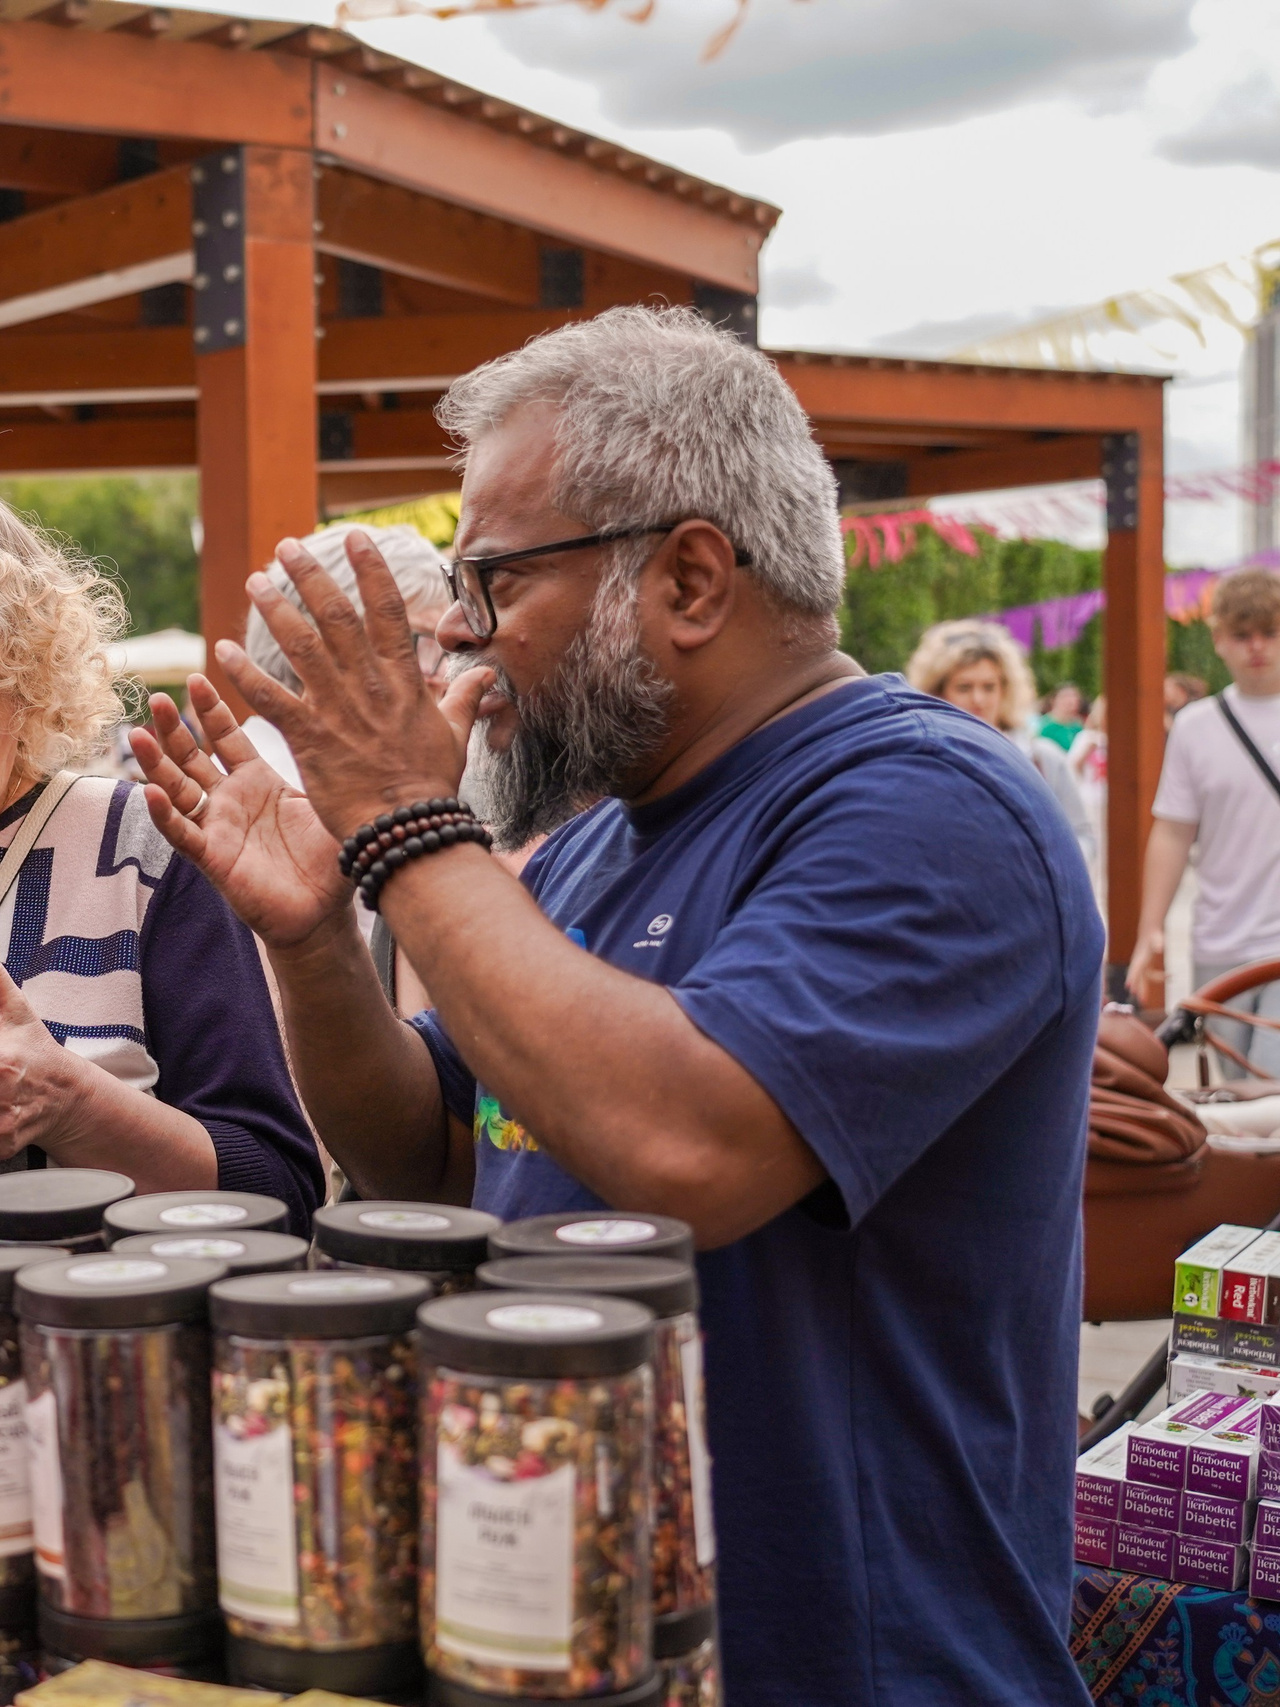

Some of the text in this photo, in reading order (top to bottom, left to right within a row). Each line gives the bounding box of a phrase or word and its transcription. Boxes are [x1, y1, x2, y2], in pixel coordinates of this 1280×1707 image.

[1232, 1285, 1246, 1309] Red
[1131, 1443, 1178, 1459] Herbodent
[1130, 1453, 1180, 1472] Diabetic
[1192, 1453, 1241, 1470] Herbodent
[1191, 1464, 1242, 1483] Diabetic
[1077, 1480, 1112, 1494] rbodent
[1126, 1489, 1173, 1505] Herbodent
[1125, 1500, 1175, 1519] Diabetic
[1186, 1500, 1235, 1516] Herbodent
[1185, 1511, 1237, 1530] Diabetic
[1075, 1523, 1105, 1537] bodent
[1075, 1534, 1107, 1550] betic
[1118, 1532, 1166, 1549] Herbodent
[1117, 1543, 1167, 1562] Diabetic
[1179, 1545, 1227, 1561] Herbodent
[1178, 1555, 1229, 1574] Diabetic
[1256, 1569, 1280, 1583] Diab
